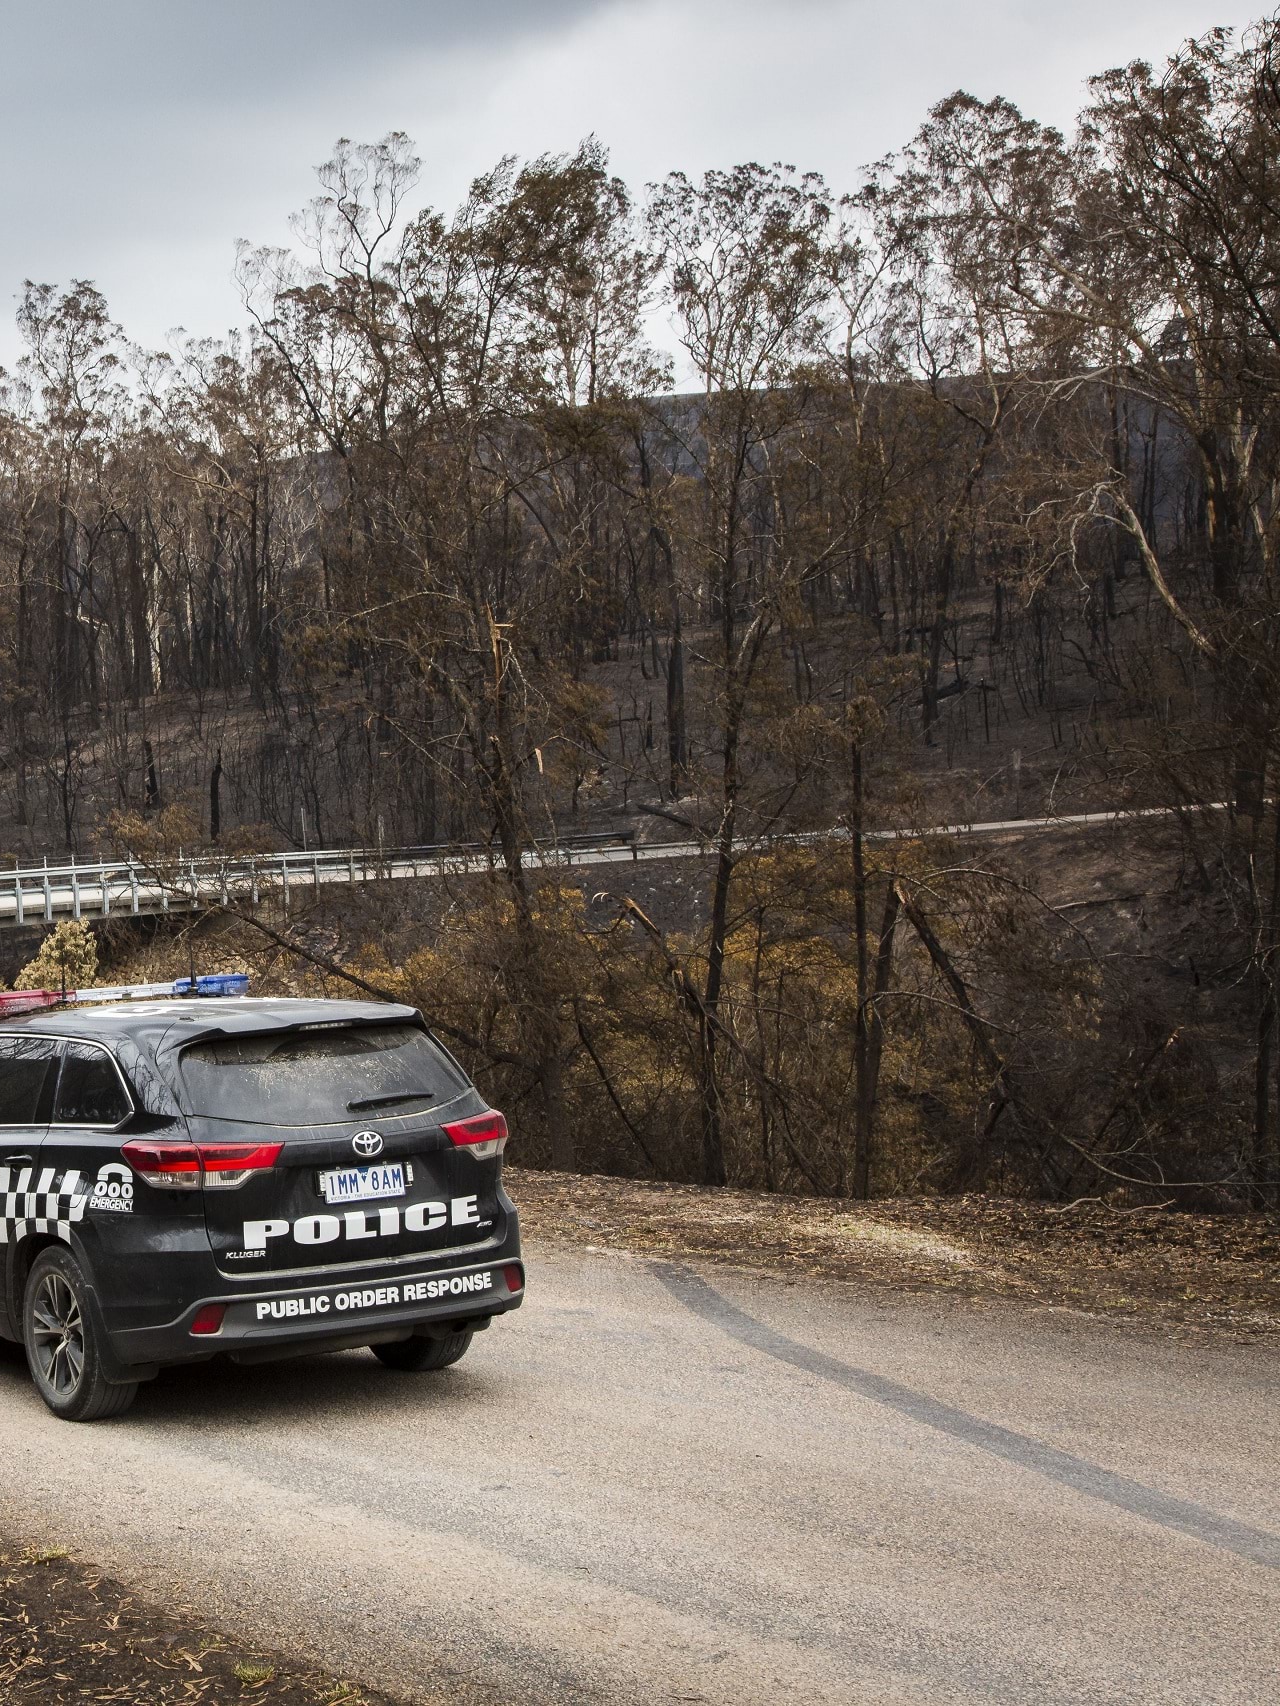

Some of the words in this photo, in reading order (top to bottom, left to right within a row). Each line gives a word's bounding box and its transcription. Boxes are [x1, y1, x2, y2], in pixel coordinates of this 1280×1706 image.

[94, 1181, 133, 1199] 000
[329, 1173, 359, 1195] 1MM
[372, 1168, 402, 1190] 8AM
[89, 1196, 133, 1212] EMERGENCY
[243, 1195, 480, 1249] POLICE
[225, 1250, 266, 1259] KLUGER
[256, 1295, 330, 1320] PUBLIC
[335, 1286, 400, 1311] ORDER
[403, 1271, 492, 1301] RESPONSE
